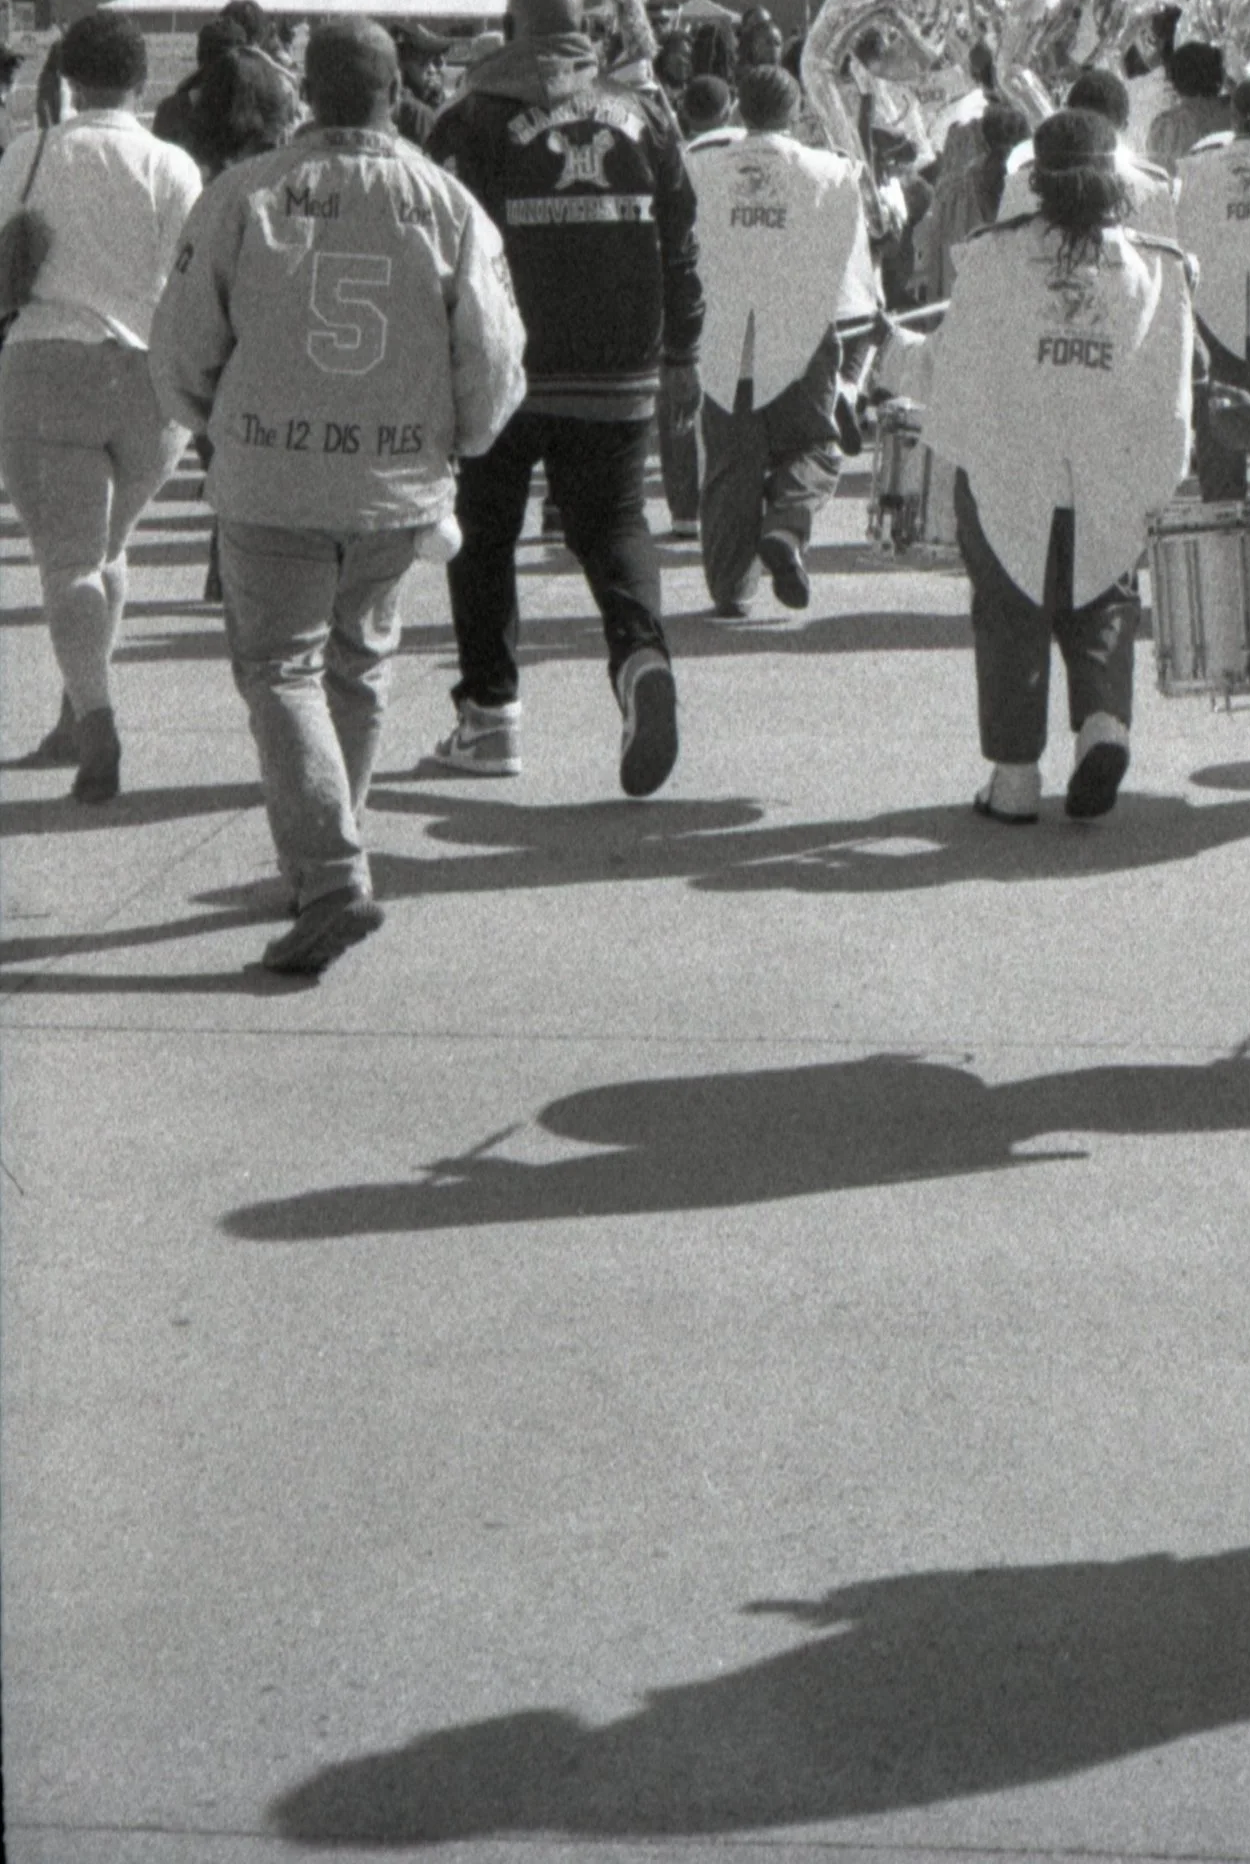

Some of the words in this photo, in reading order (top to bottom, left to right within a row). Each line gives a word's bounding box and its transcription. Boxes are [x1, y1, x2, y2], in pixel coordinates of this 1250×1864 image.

[729, 206, 788, 229] FORCE
[306, 250, 393, 376] 5
[1037, 337, 1114, 372] FORCE
[241, 411, 278, 450] The
[285, 417, 311, 451] 12
